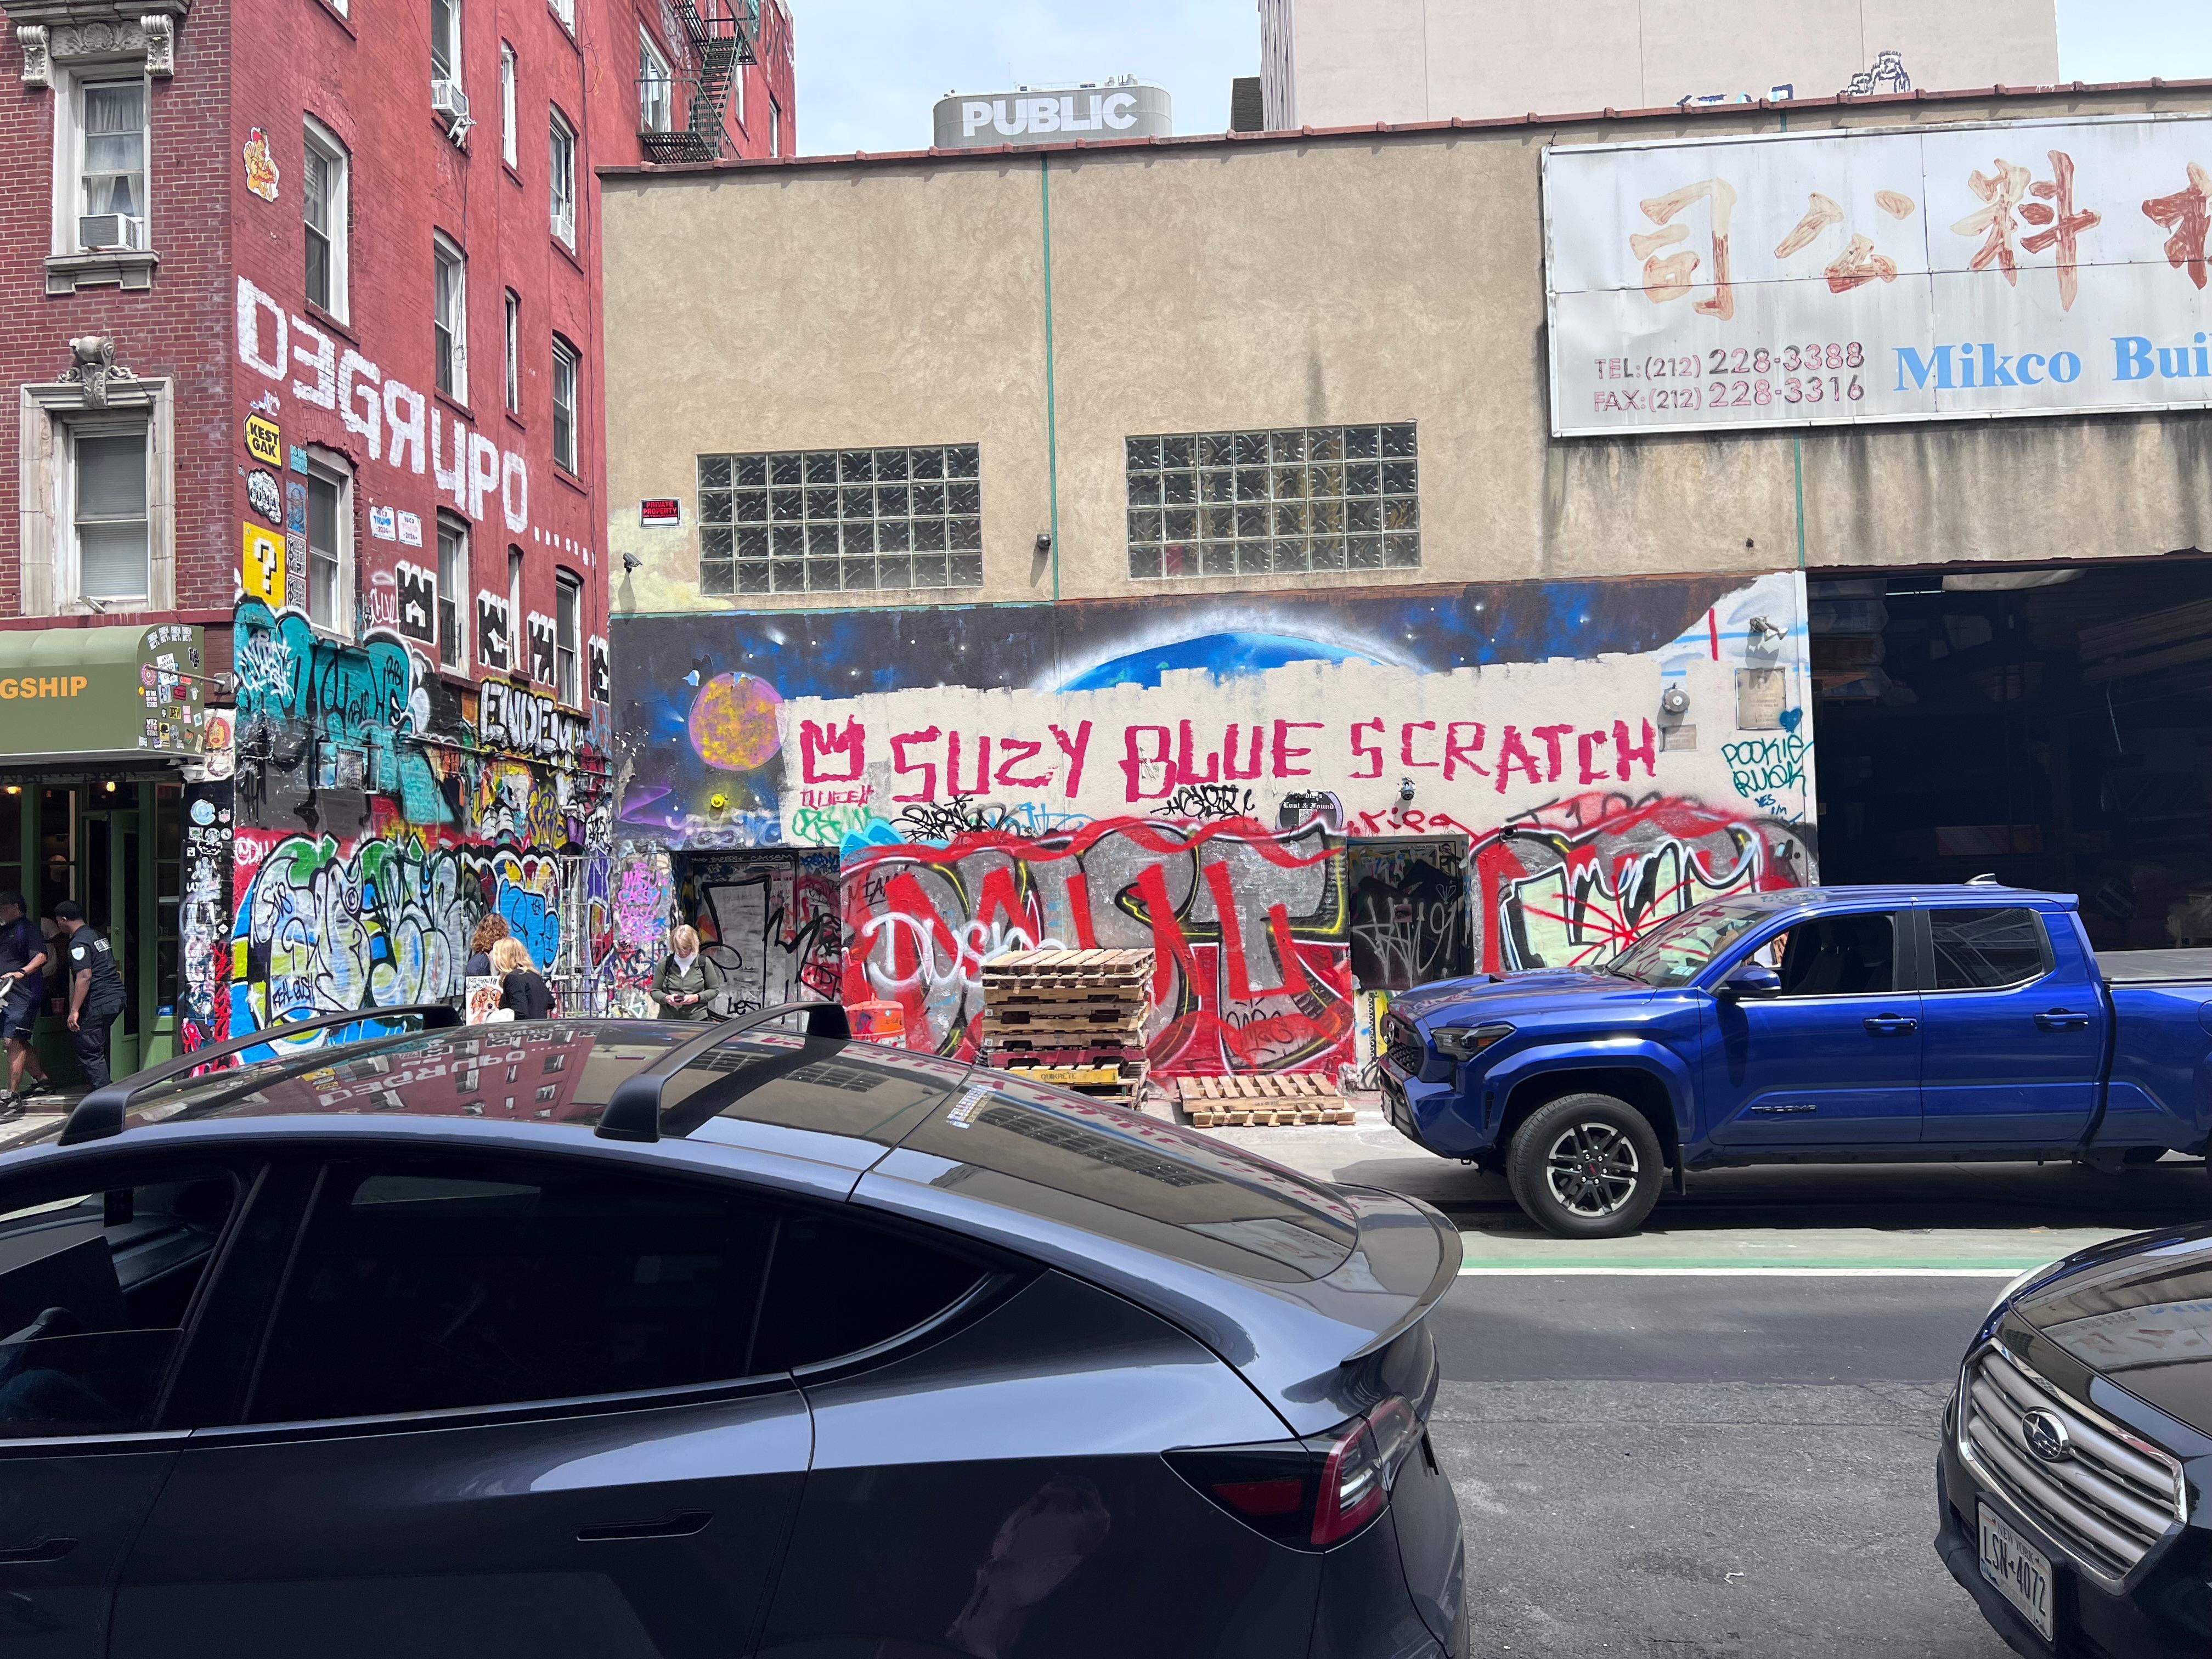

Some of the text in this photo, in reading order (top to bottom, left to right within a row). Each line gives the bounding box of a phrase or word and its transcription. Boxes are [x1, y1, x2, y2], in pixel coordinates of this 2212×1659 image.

[962, 92, 1138, 137] PUBLIC
[1708, 341, 1864, 375] 228-3388
[1892, 331, 2212, 391] Mikco Bui
[1708, 374, 1865, 409] 228-3316
[250, 422, 279, 445] KEST
[252, 437, 277, 458] GAK
[890, 720, 1093, 803] SUZY
[1119, 719, 1325, 802] BLUE
[1349, 716, 1657, 794] SCRATCH
[1721, 733, 1814, 770] POOKIE
[1754, 794, 1776, 808] YES
[1997, 1525, 2035, 1565] NEW YORK
